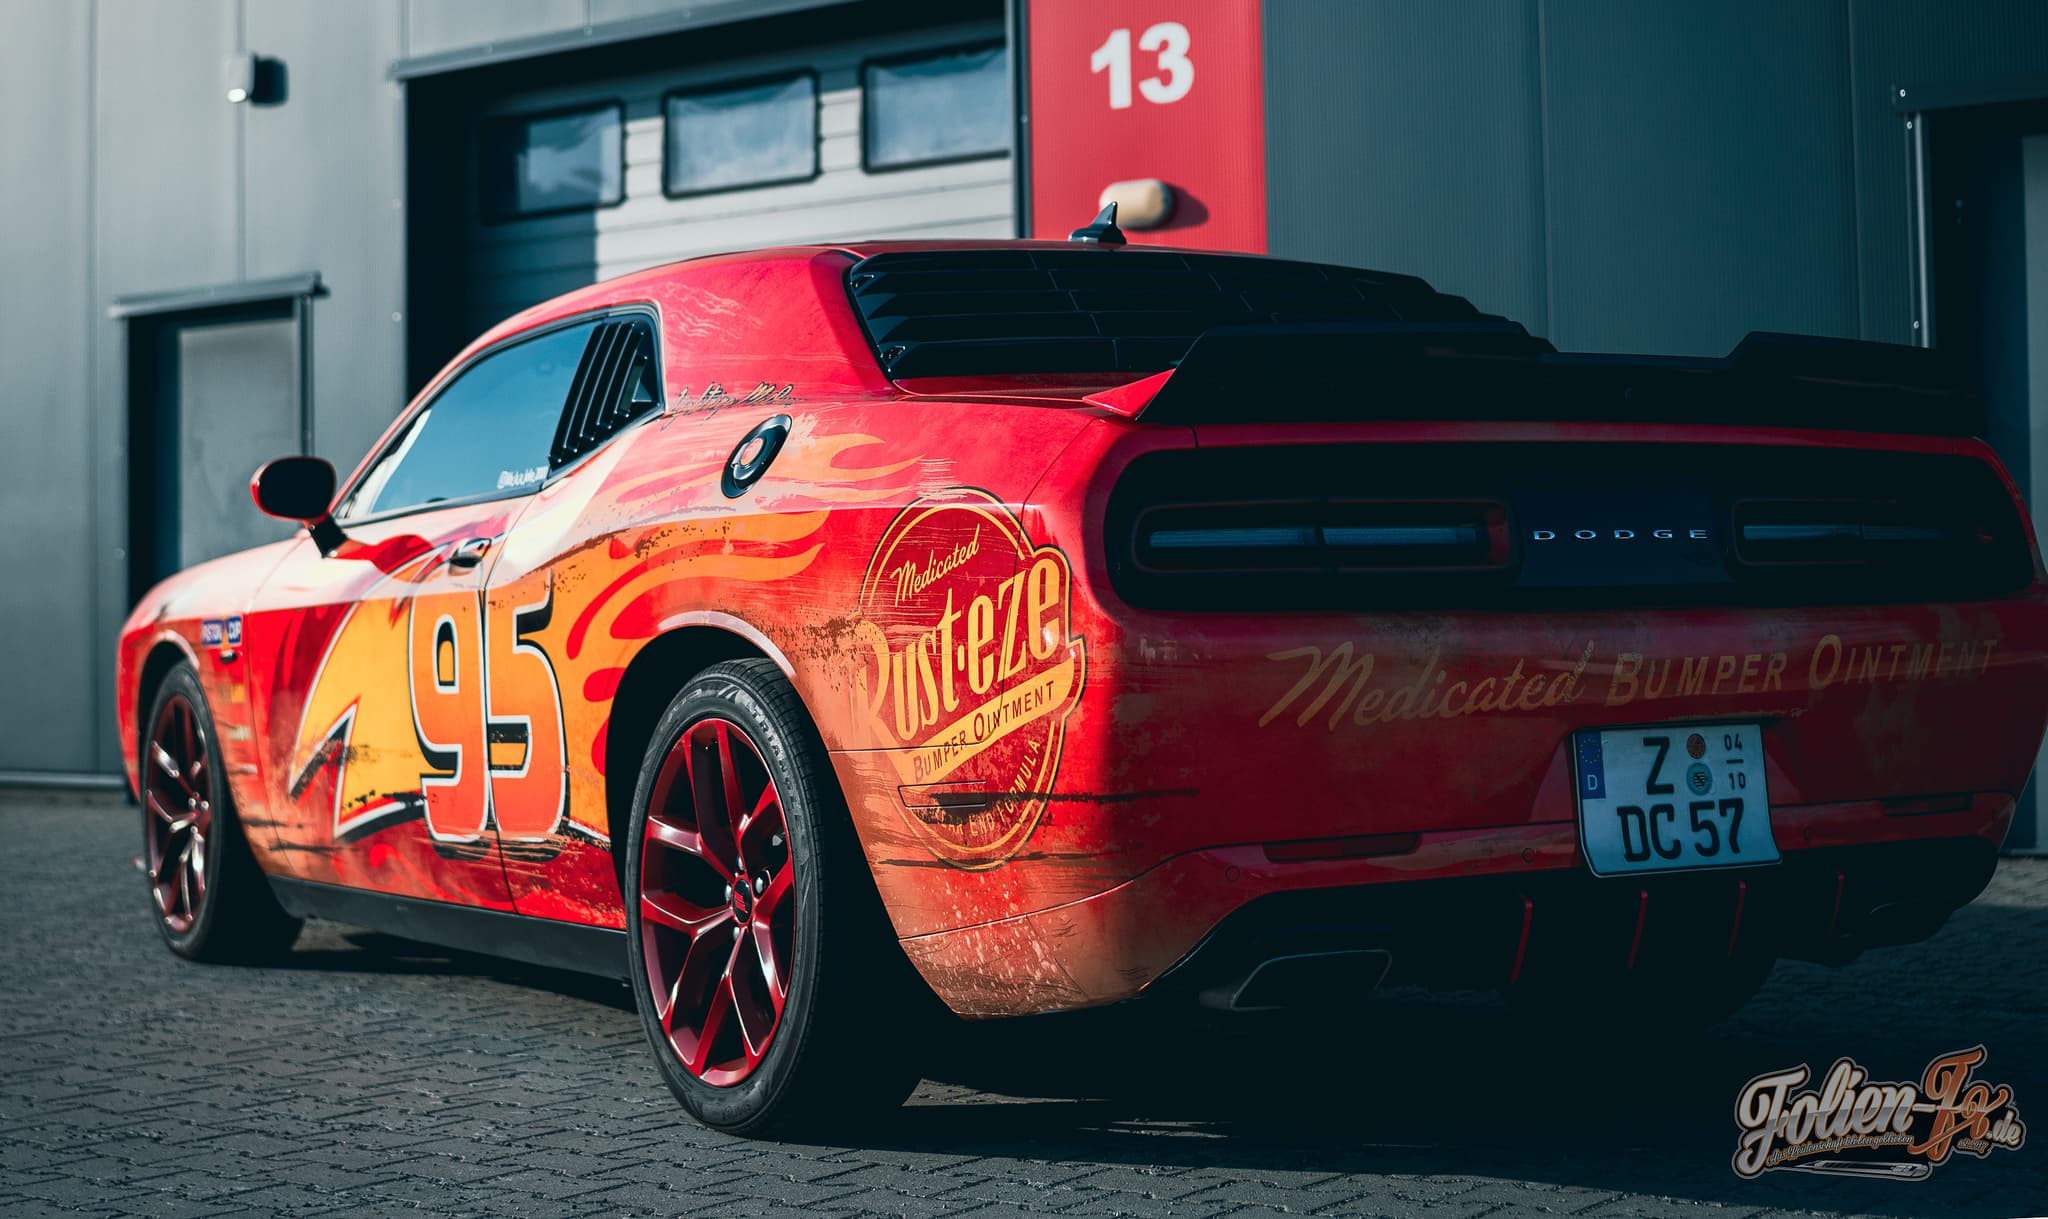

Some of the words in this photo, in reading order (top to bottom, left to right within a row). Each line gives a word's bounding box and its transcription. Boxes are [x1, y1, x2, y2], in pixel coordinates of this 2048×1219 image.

[1091, 21, 1195, 109] 13
[890, 523, 980, 608] Medicated
[1533, 529, 1708, 540] DODGE
[410, 566, 568, 848] 95
[1258, 640, 1595, 731] Medicated
[1605, 651, 1788, 706] BUMPER
[1808, 634, 1998, 692] OINTMENT
[913, 729, 968, 782] BUMPER
[973, 680, 1055, 741] OINTMENT
[1643, 736, 1675, 795] Z
[1724, 734, 1743, 750] 04
[968, 811, 995, 837] END
[997, 739, 1041, 826] FORMULA
[1586, 774, 1598, 790] D
[1728, 772, 1746, 789] 10
[1616, 803, 1682, 862] DC
[1689, 797, 1745, 857] 57
